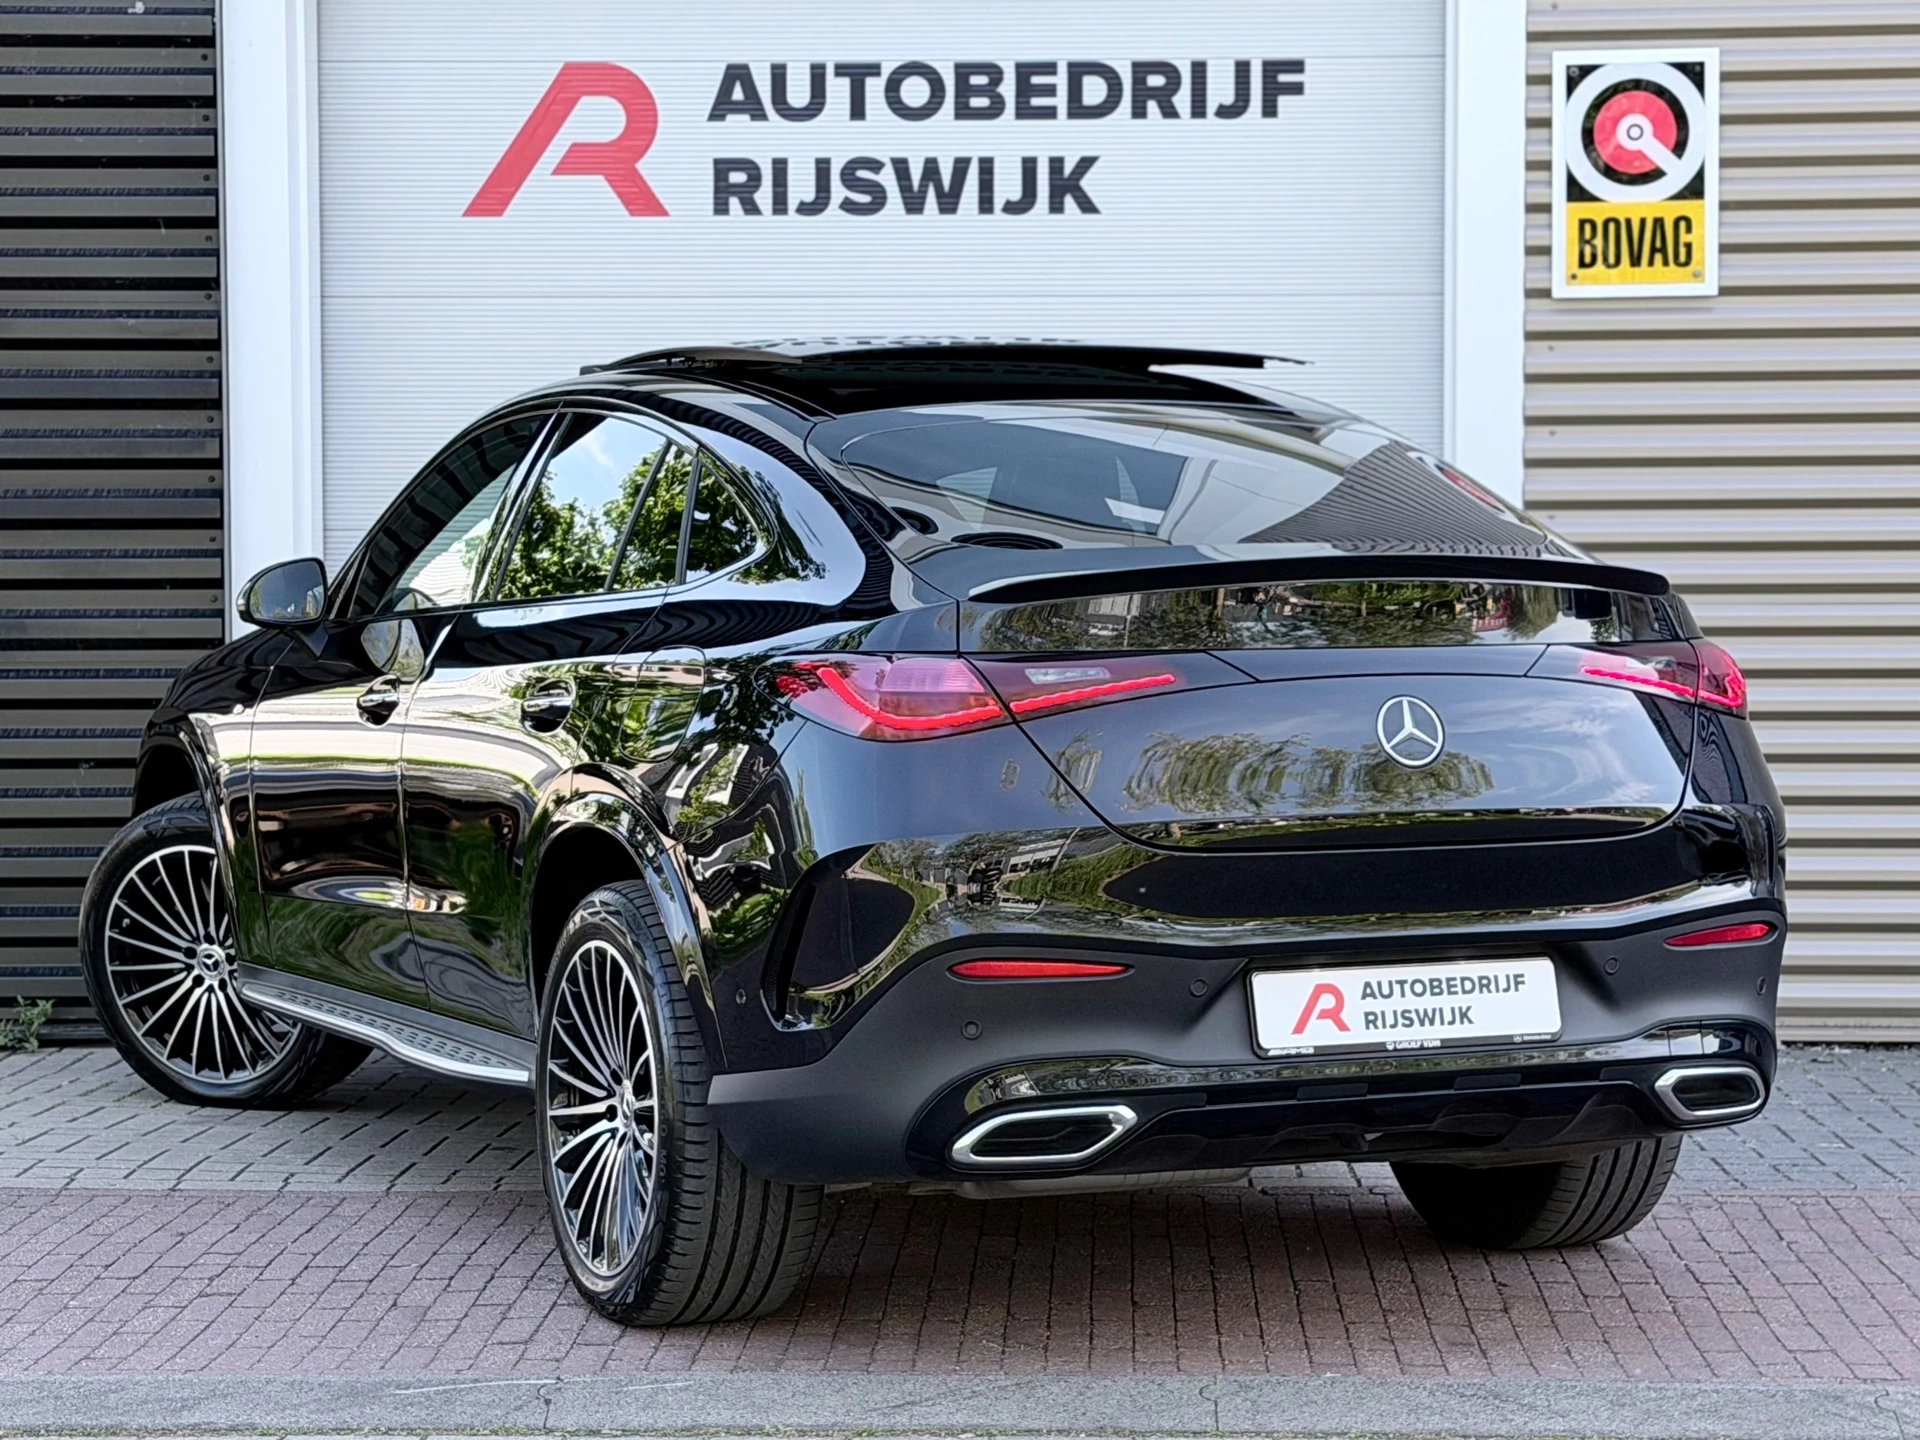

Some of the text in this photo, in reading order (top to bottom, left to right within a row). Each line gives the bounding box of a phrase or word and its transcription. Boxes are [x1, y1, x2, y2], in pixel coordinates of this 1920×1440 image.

[707, 60, 1306, 122] AUTOBEDRIJF
[713, 156, 1101, 217] RIJSWIJK
[1578, 215, 1693, 269] BOVAG
[1361, 973, 1526, 1000] AUTOBEDRIJF
[1364, 1006, 1474, 1031] RIJSWIJK
